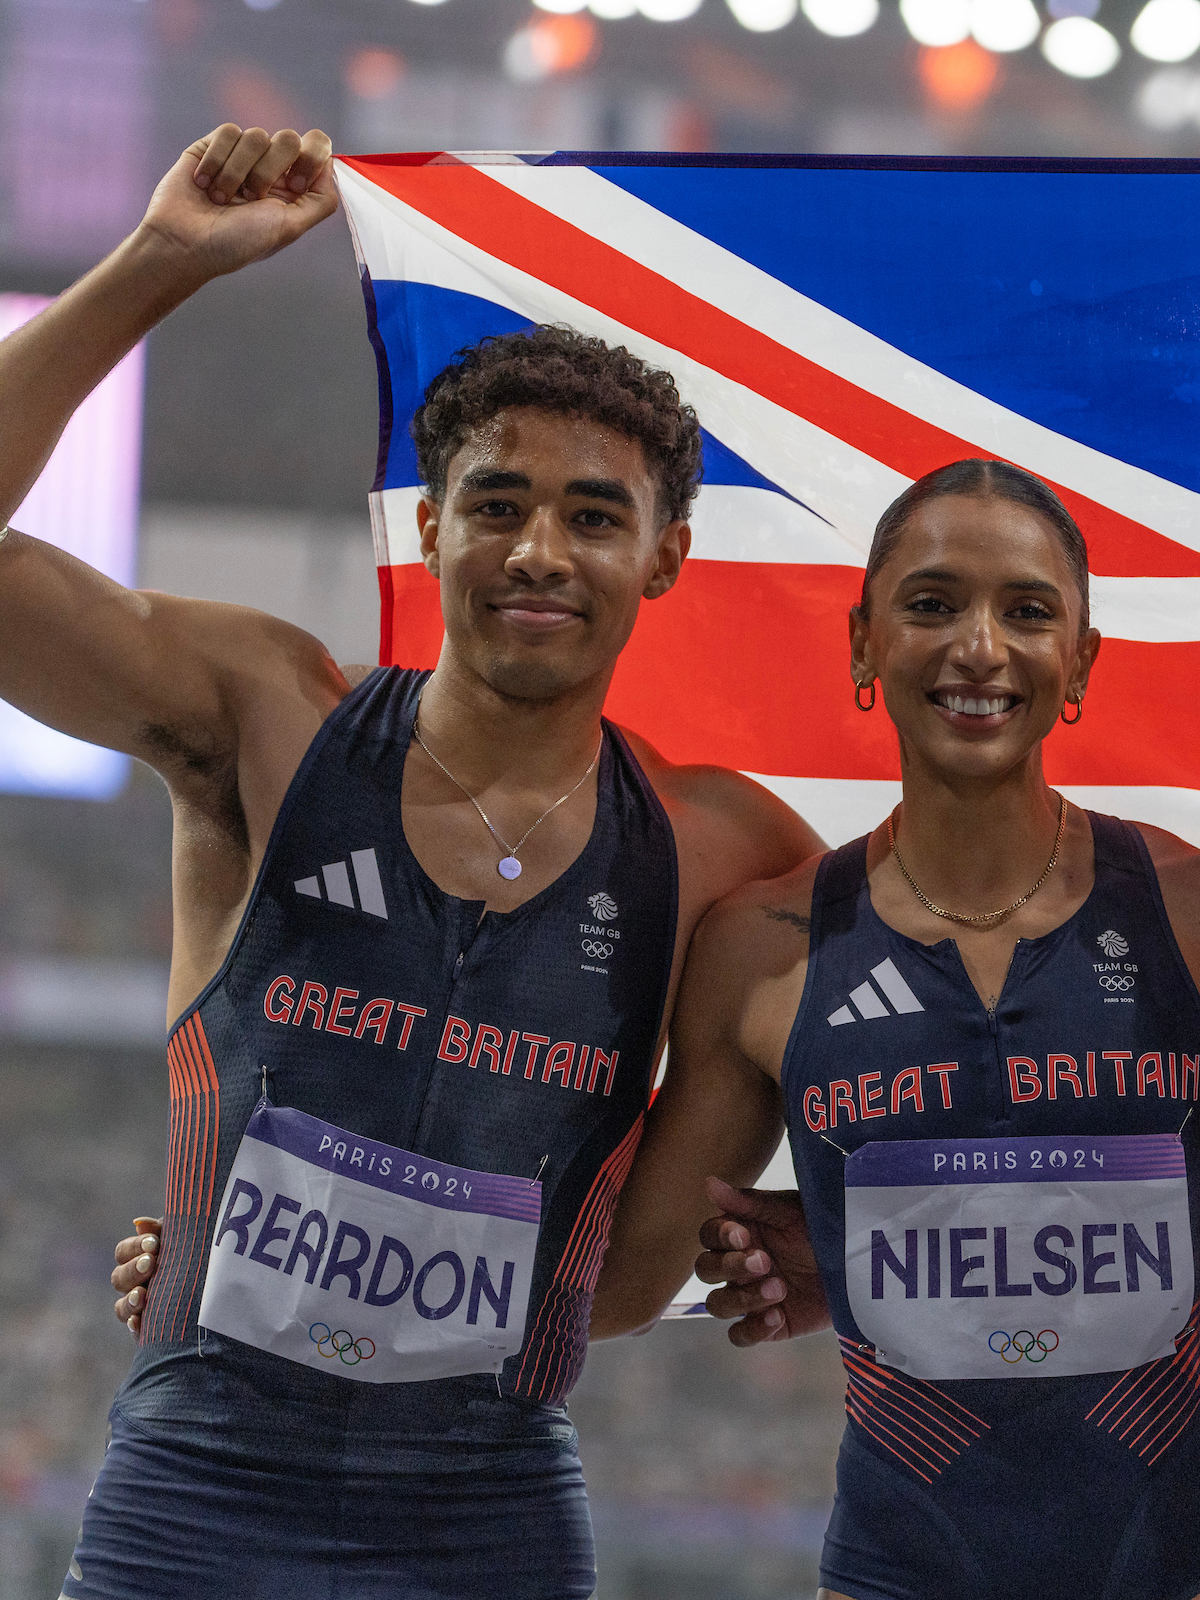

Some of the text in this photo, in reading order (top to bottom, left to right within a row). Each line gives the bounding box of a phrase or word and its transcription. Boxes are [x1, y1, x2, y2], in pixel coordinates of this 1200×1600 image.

[579, 923, 621, 939] TEAM GB
[1093, 962, 1139, 973] TEAM GB
[263, 974, 621, 1096] GREAT BRITAIN
[802, 1049, 1200, 1133] GREAT BRITAIN
[402, 1164, 473, 1200] 2024
[1029, 1149, 1104, 1169] 2024
[214, 1177, 516, 1330] REARDON
[870, 1221, 1175, 1300] NIELSEN
